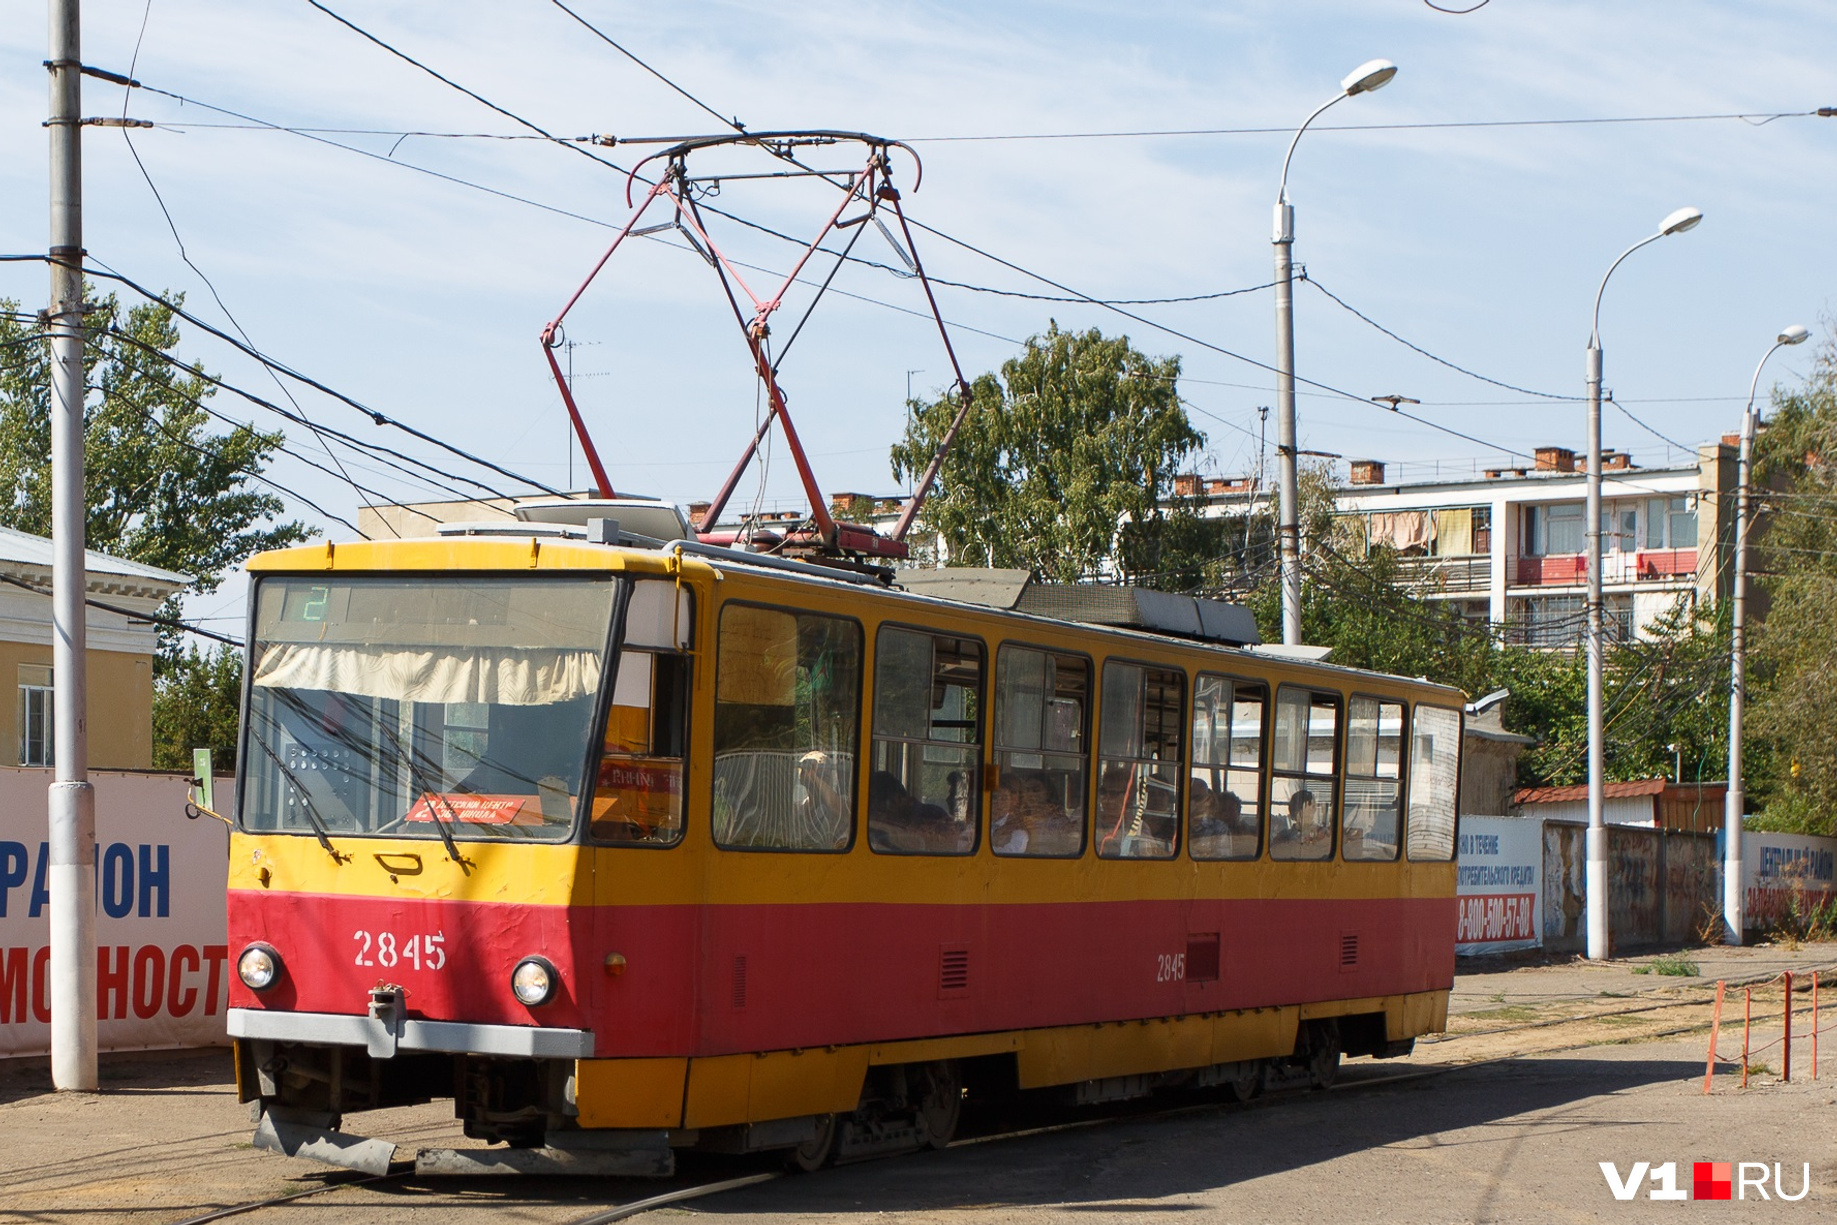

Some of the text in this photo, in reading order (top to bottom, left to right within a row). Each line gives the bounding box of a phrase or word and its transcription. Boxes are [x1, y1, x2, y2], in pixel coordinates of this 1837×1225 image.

[303, 586, 328, 620] 2
[414, 800, 436, 818] 2
[459, 810, 497, 819] ШКОЛА
[481, 801, 514, 810] ЦЕНТР
[1475, 835, 1499, 855] ТЕЧЕНИЕ
[0, 841, 170, 918] РАОН
[1458, 897, 1530, 940] 8-800-500-57-80
[353, 930, 446, 971] 2845
[1157, 953, 1184, 982] 2845
[0, 944, 229, 1024] МОНОСТ
